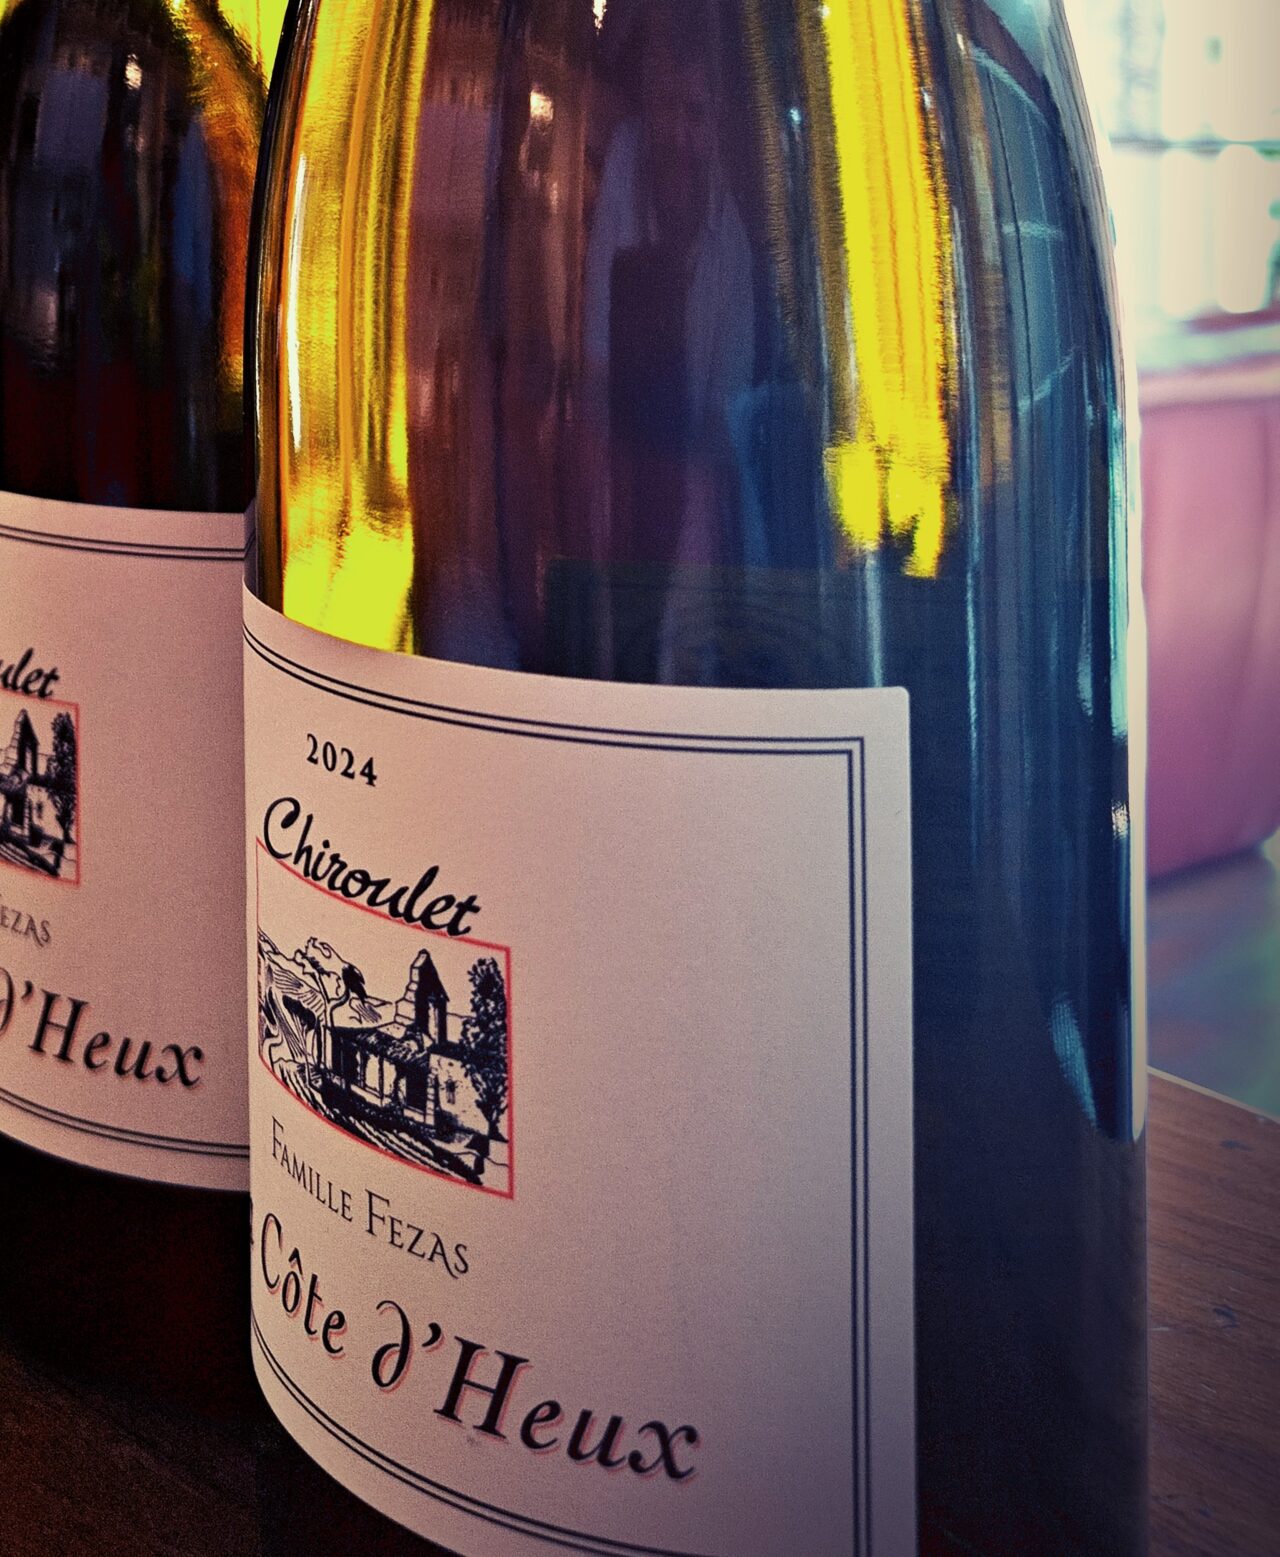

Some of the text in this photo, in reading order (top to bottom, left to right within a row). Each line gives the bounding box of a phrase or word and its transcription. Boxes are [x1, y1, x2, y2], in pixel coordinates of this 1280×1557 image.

[305, 732, 378, 788] 2024
[262, 796, 481, 937] Chiroulet
[270, 1116, 354, 1222] FAMILLE
[363, 1188, 470, 1280] FEZAS
[260, 1212, 701, 1483] Côte d'Heux
